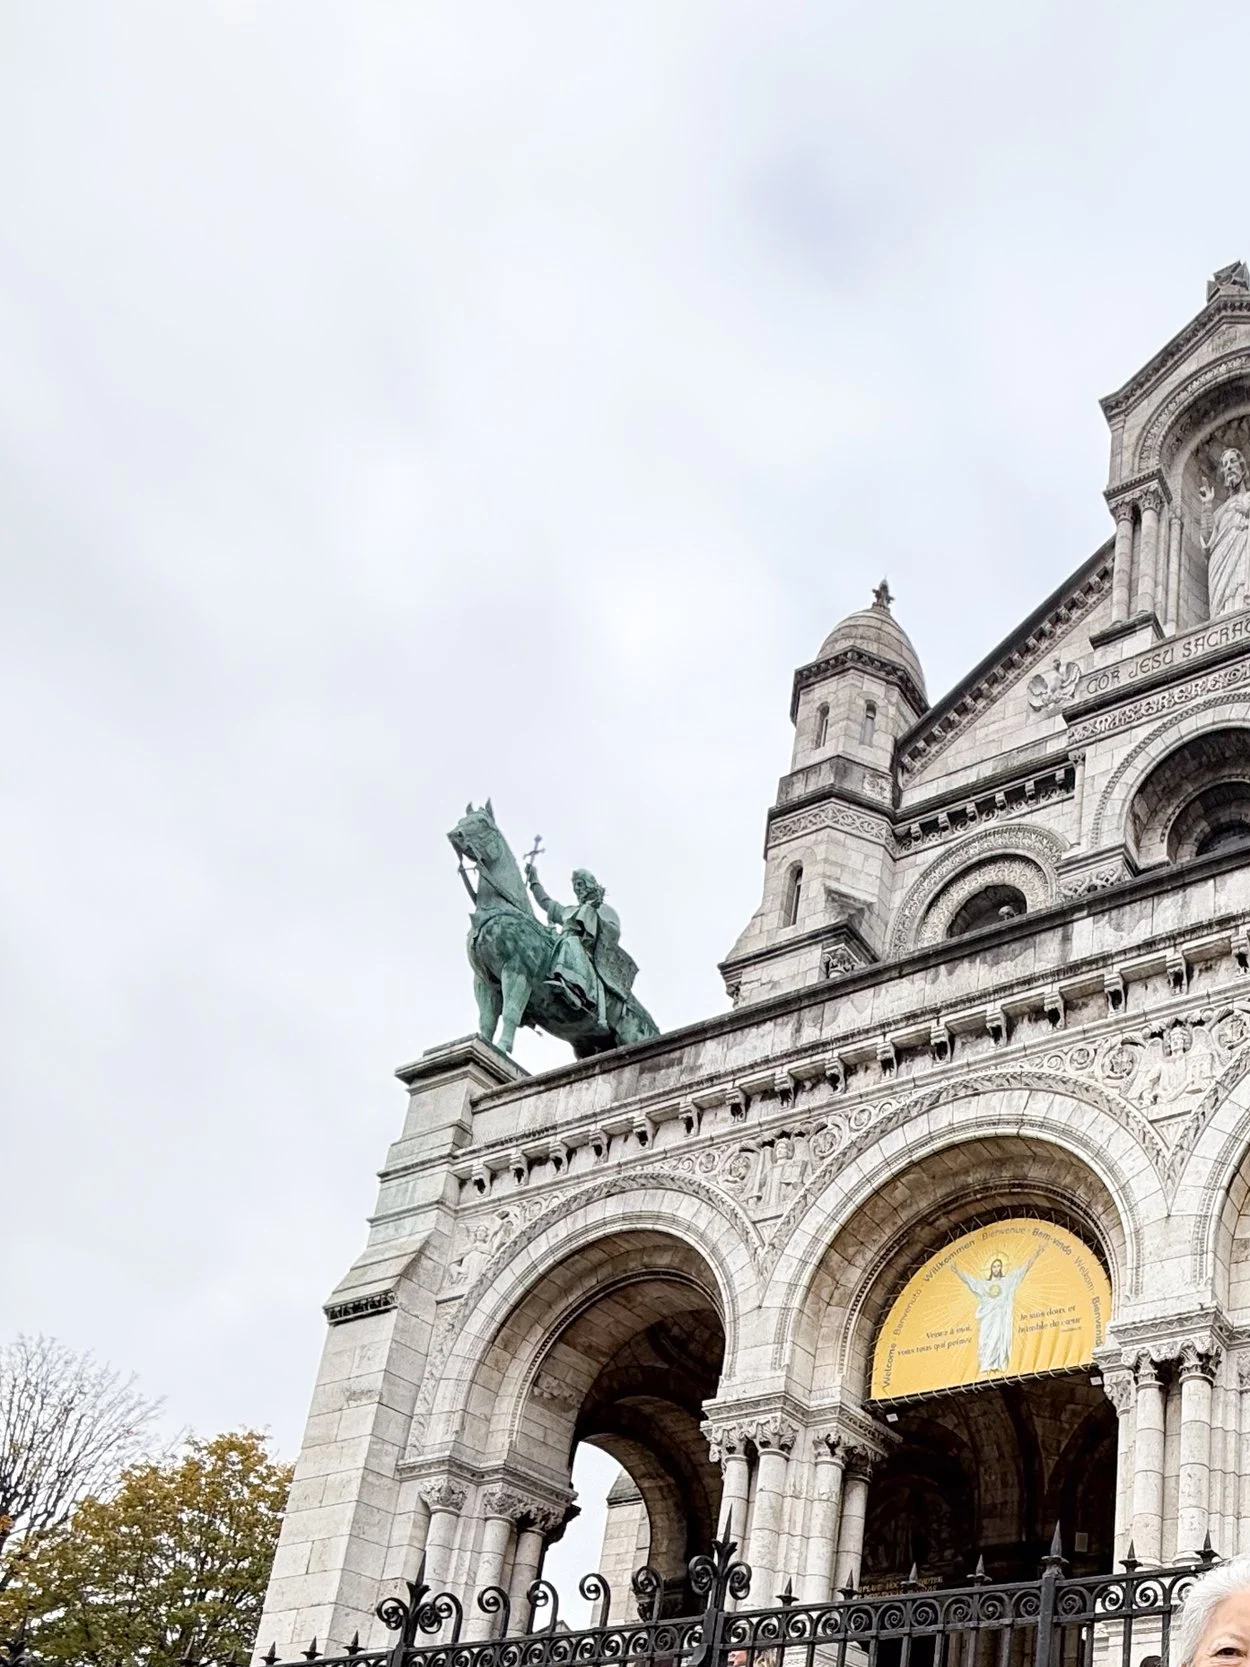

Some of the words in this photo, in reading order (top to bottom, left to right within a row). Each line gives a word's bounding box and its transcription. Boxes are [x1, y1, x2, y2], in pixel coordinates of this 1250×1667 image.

[1086, 669, 1121, 695] COR
[1128, 648, 1174, 678] JESU
[1092, 1296, 1104, 1348] Bienvenid
